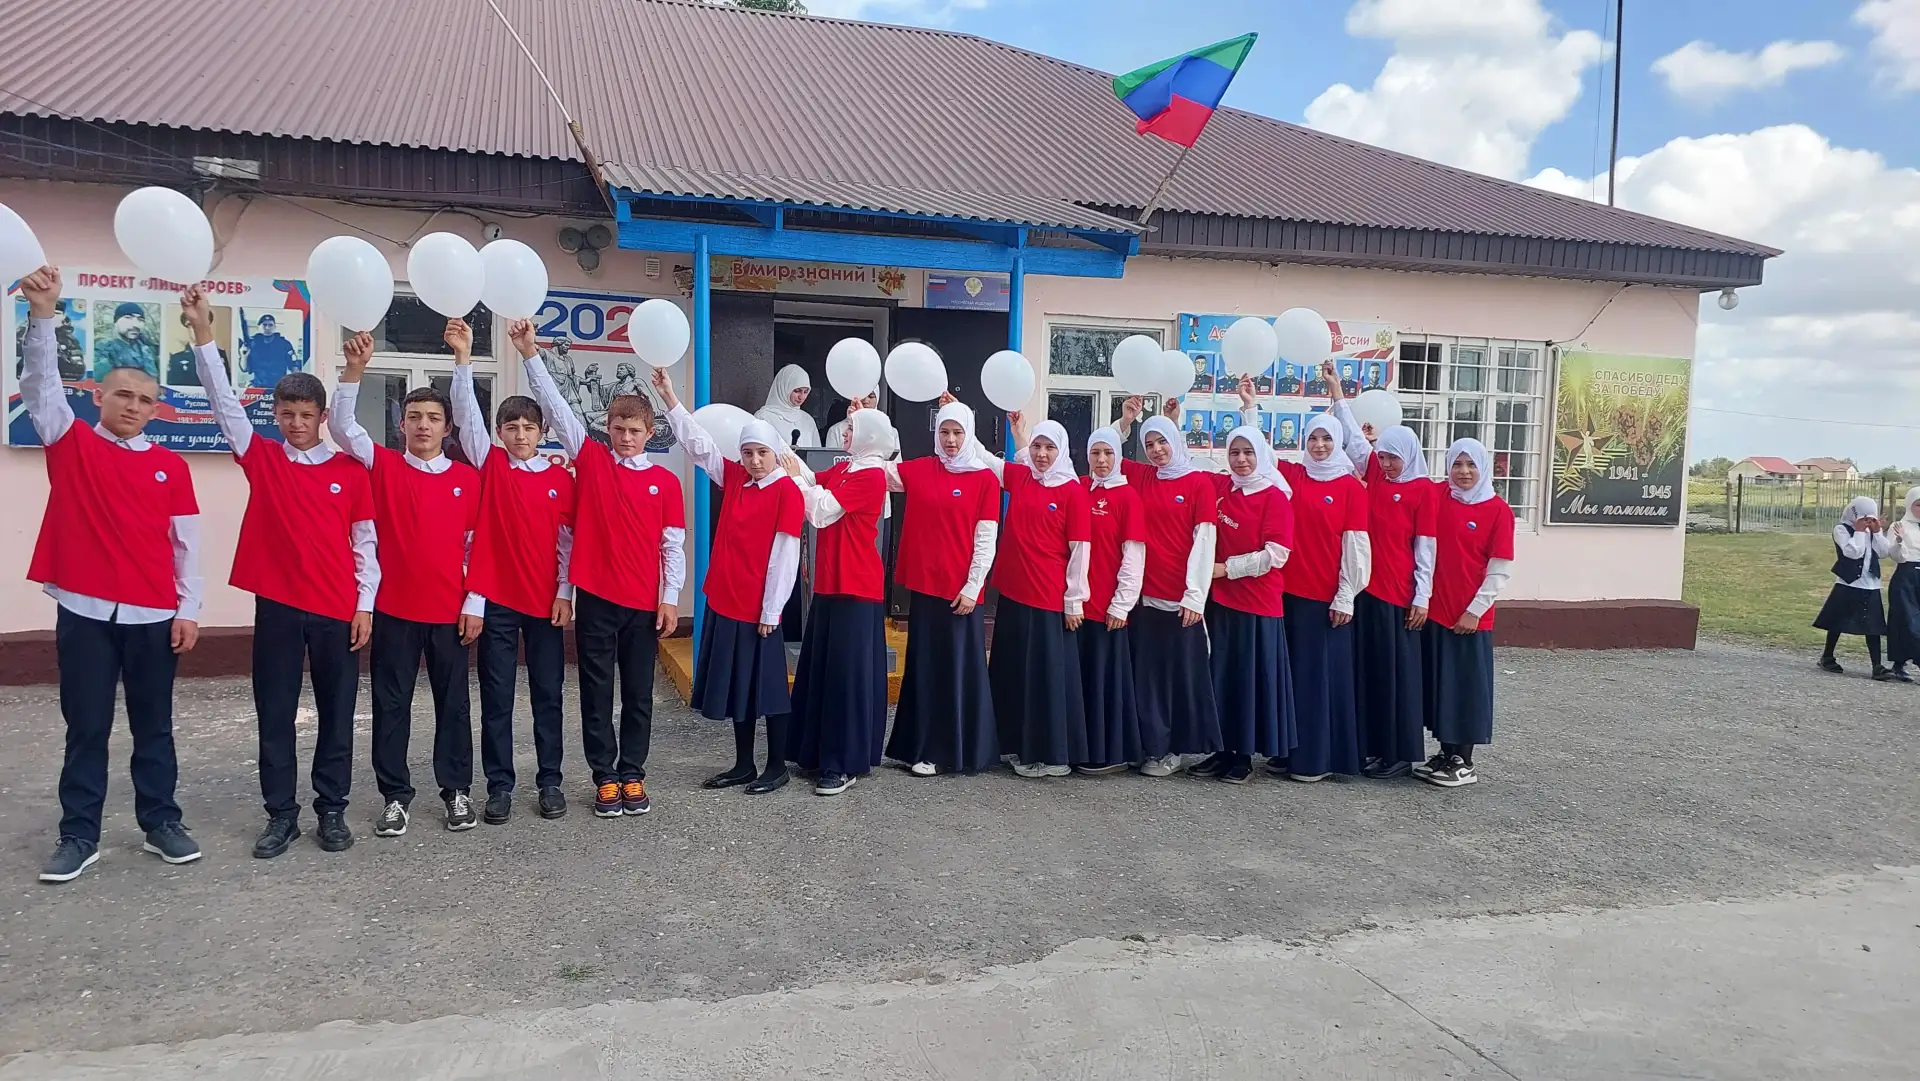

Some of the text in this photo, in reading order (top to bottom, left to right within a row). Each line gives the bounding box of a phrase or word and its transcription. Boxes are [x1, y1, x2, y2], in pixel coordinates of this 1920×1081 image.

[733, 263, 743, 275] В
[750, 264, 790, 281] мир
[795, 266, 865, 282] знаний
[78, 273, 136, 289] ПРОЕКТ
[200, 279, 252, 294] ЕРОЕВ»
[535, 300, 634, 342] 202
[1595, 370, 1686, 386] СПАСИБО ДЕДУ
[240, 393, 275, 401] МУРТАЗА
[1593, 383, 1664, 397] ЗА ПОБЕДУ!
[171, 434, 185, 443] не
[188, 431, 229, 448] умира
[1608, 465, 1639, 480] 1941
[1641, 484, 1672, 499] 1945
[1560, 494, 1669, 516] Мы помним
